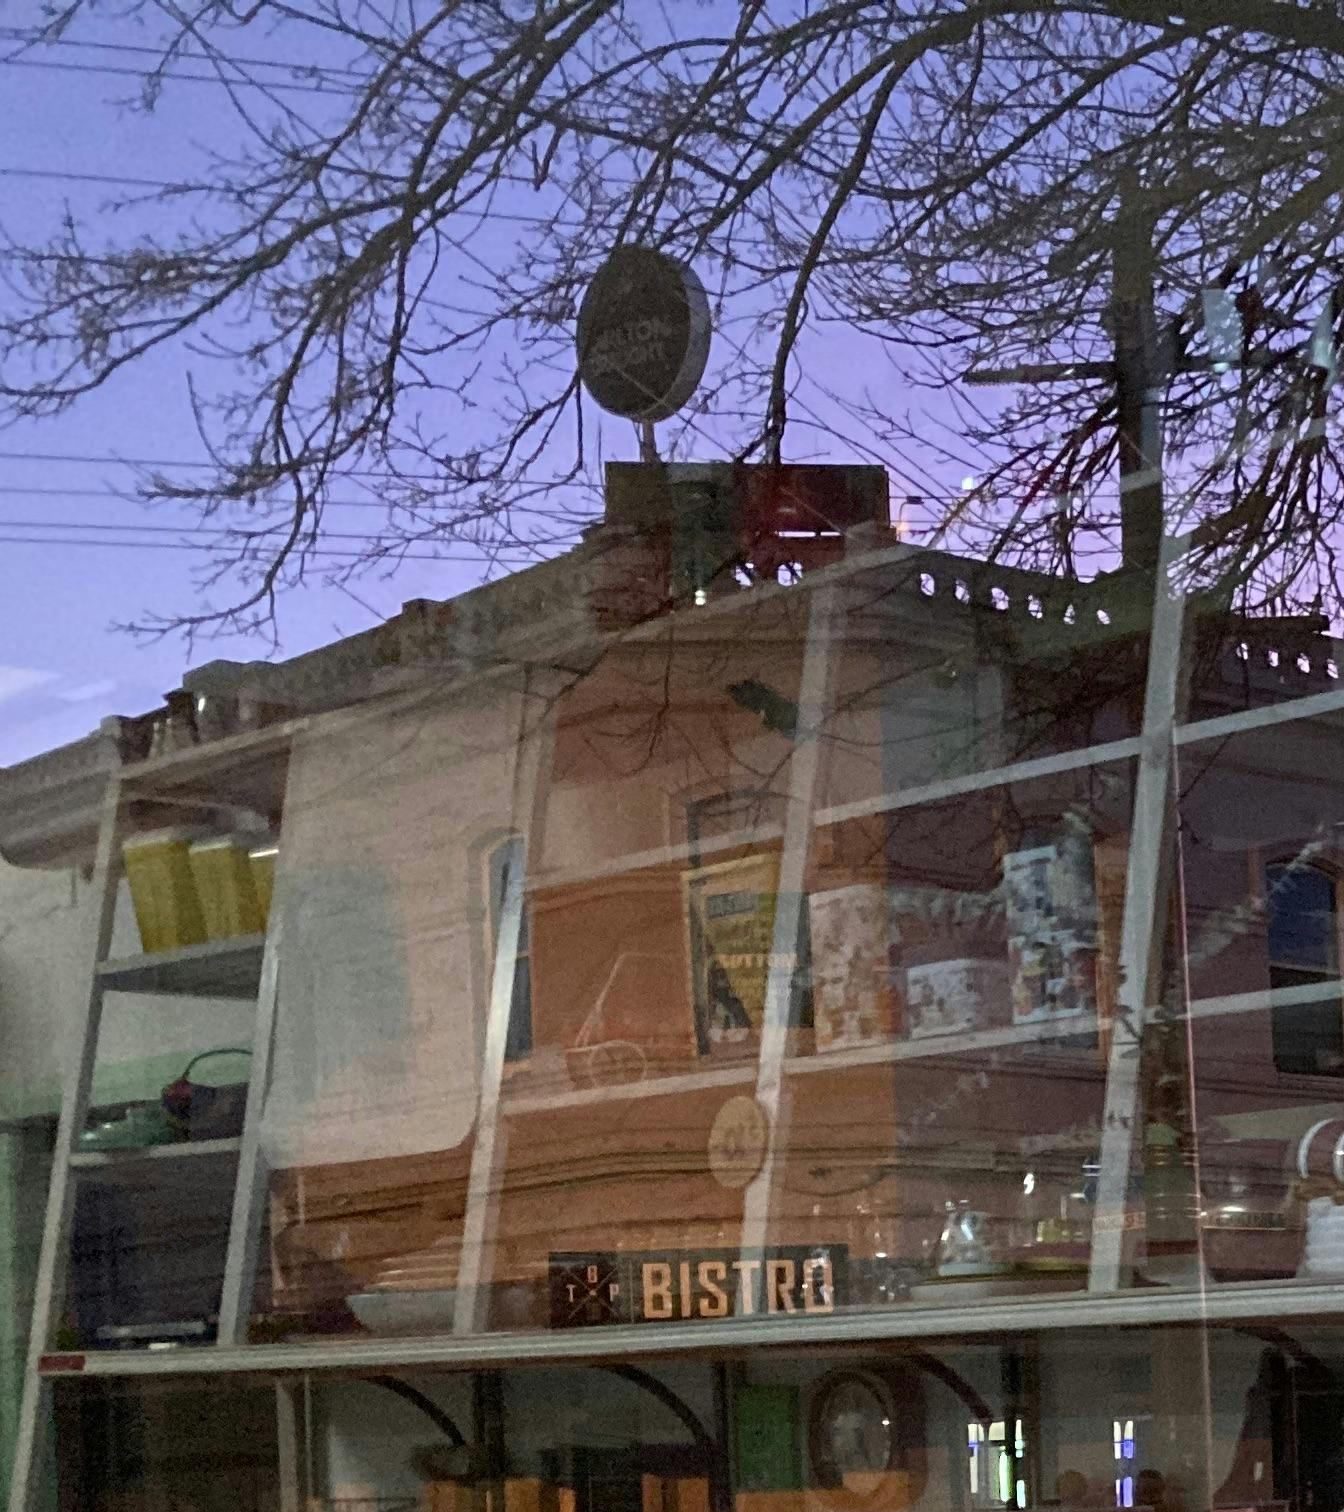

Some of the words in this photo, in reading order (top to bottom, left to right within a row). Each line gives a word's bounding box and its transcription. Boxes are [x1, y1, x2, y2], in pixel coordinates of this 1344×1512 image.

[566, 1283, 577, 1303] T
[608, 1283, 620, 1302] P
[641, 1259, 834, 1319] BISTRO
